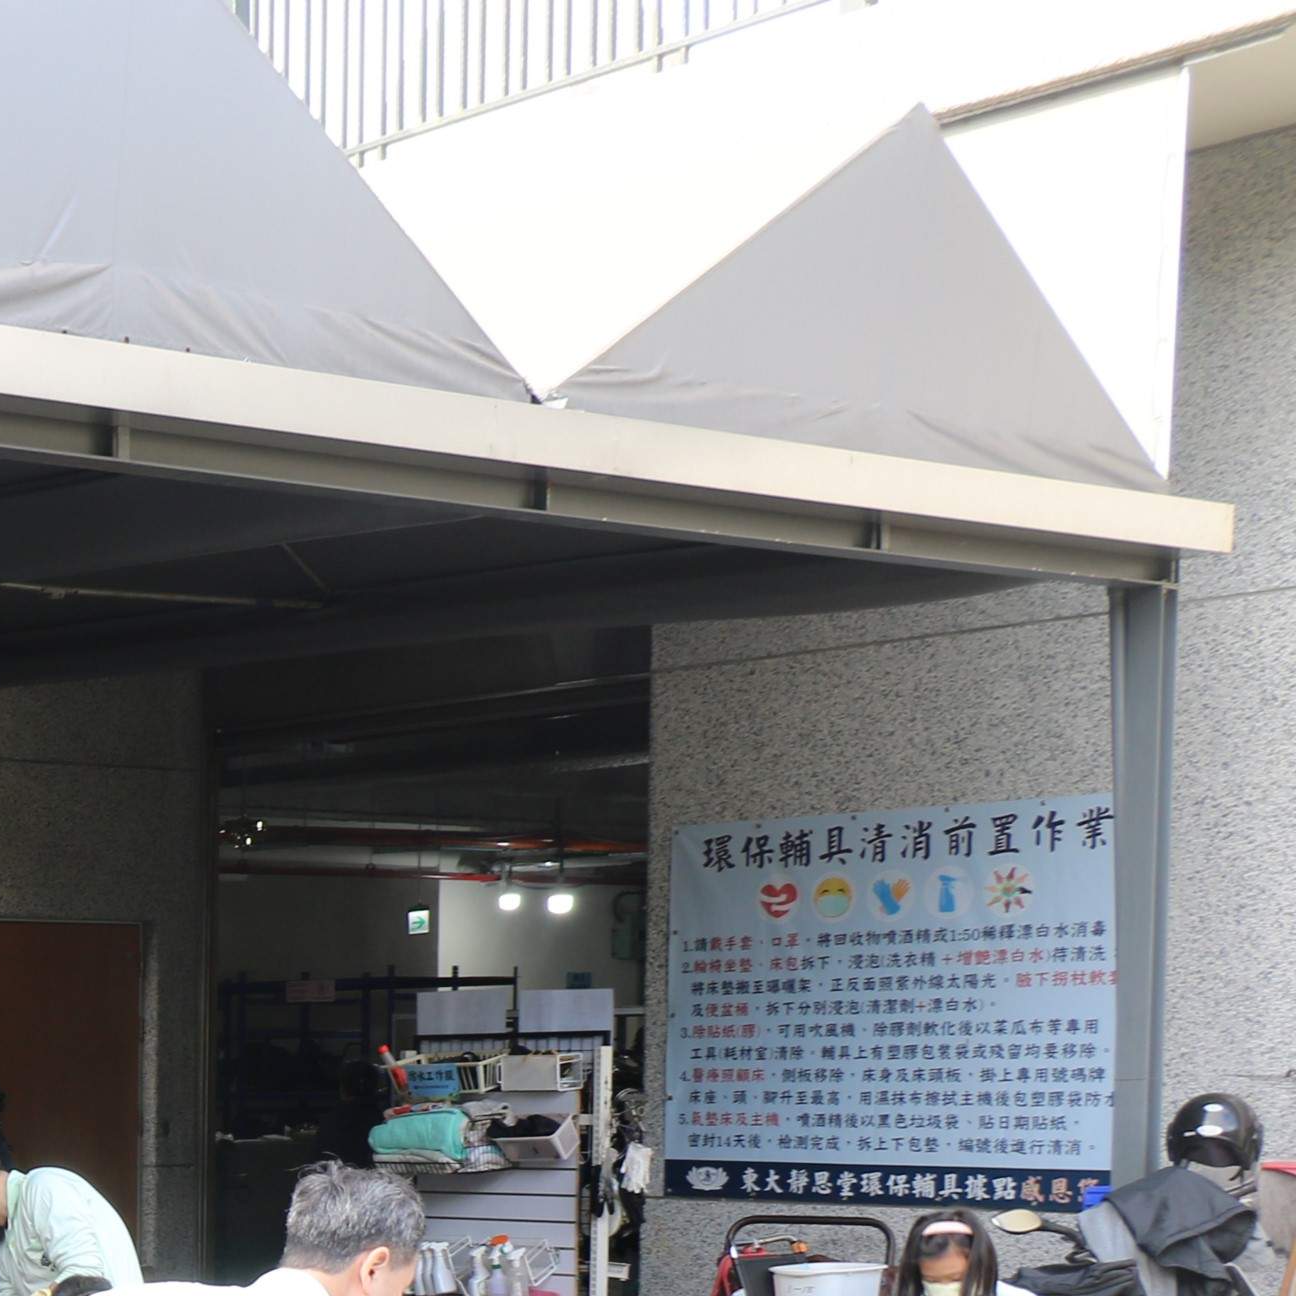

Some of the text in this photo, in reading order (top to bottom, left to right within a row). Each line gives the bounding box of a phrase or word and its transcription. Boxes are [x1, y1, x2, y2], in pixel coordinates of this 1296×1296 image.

[703, 806, 1114, 873] 環保輔具清消前置作業
